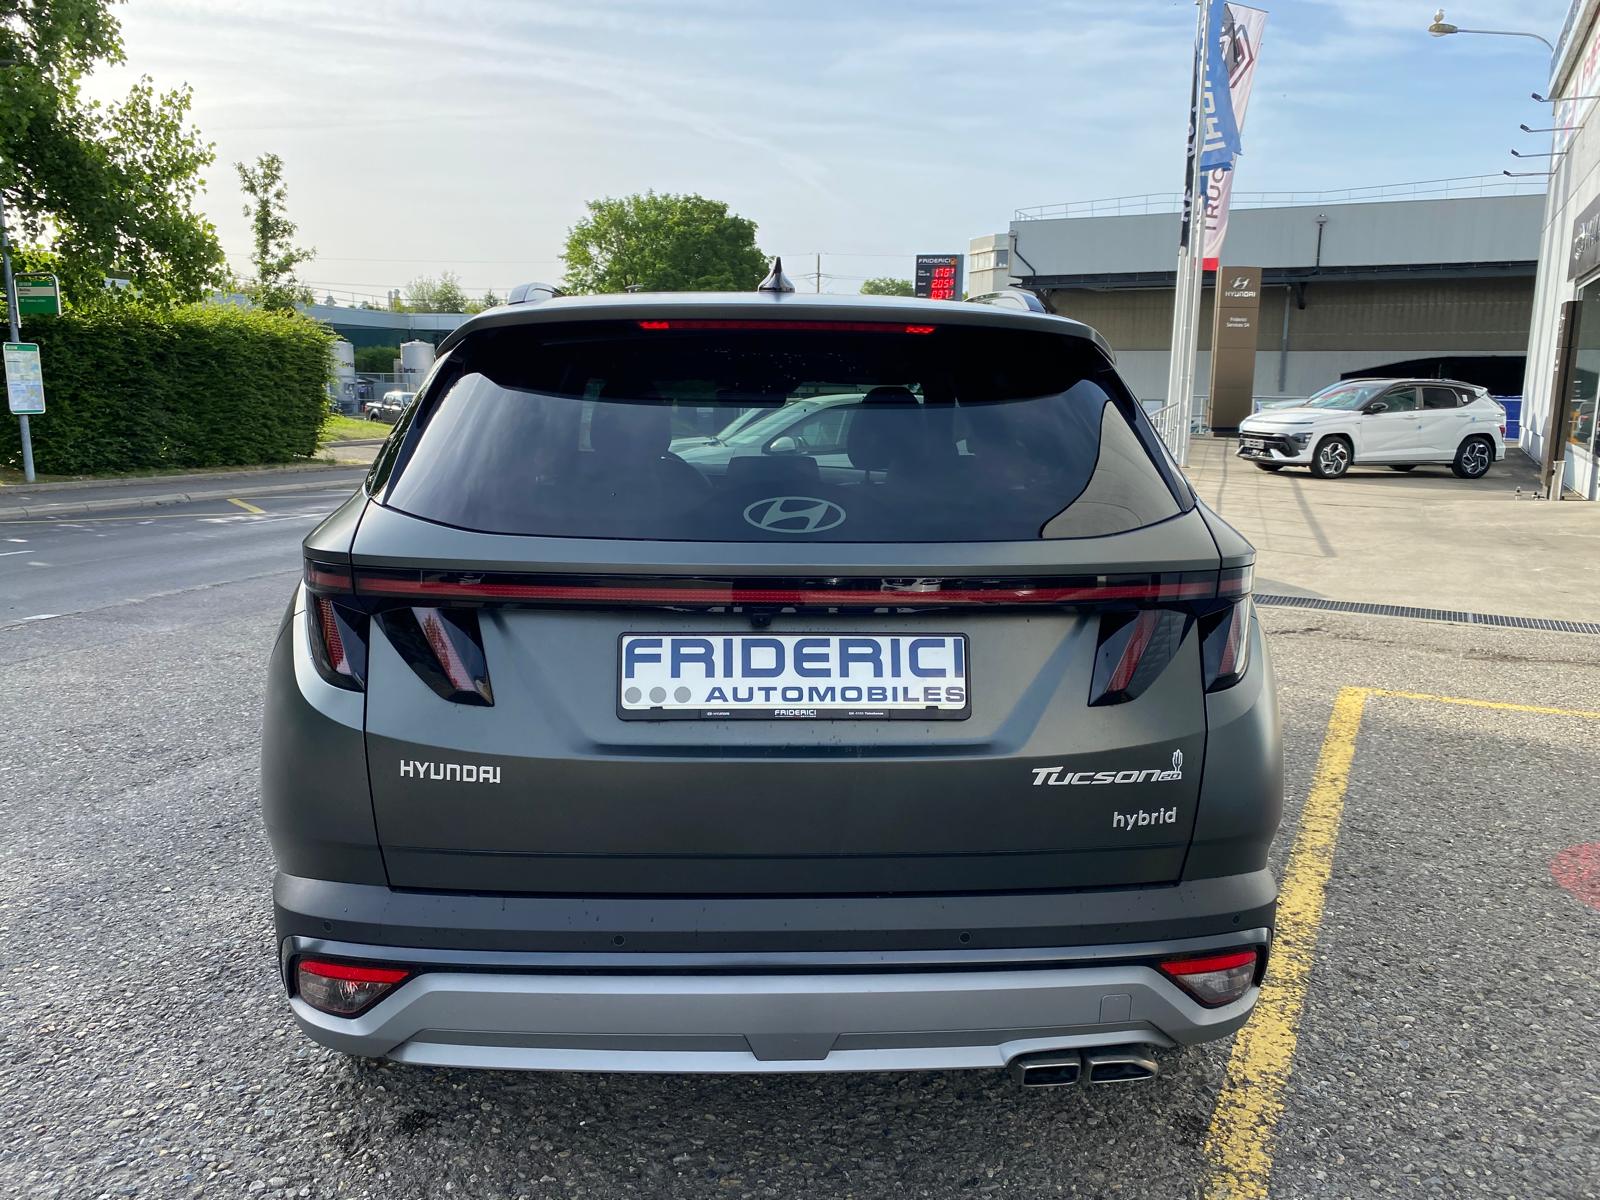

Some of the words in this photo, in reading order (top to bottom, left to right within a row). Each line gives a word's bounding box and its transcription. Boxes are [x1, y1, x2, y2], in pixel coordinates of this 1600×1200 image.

[624, 638, 964, 679] FRIDERICI
[704, 686, 965, 703] AUTOMOBILES
[400, 759, 501, 784] HYUNDAI
[1112, 806, 1177, 831] hybrid
